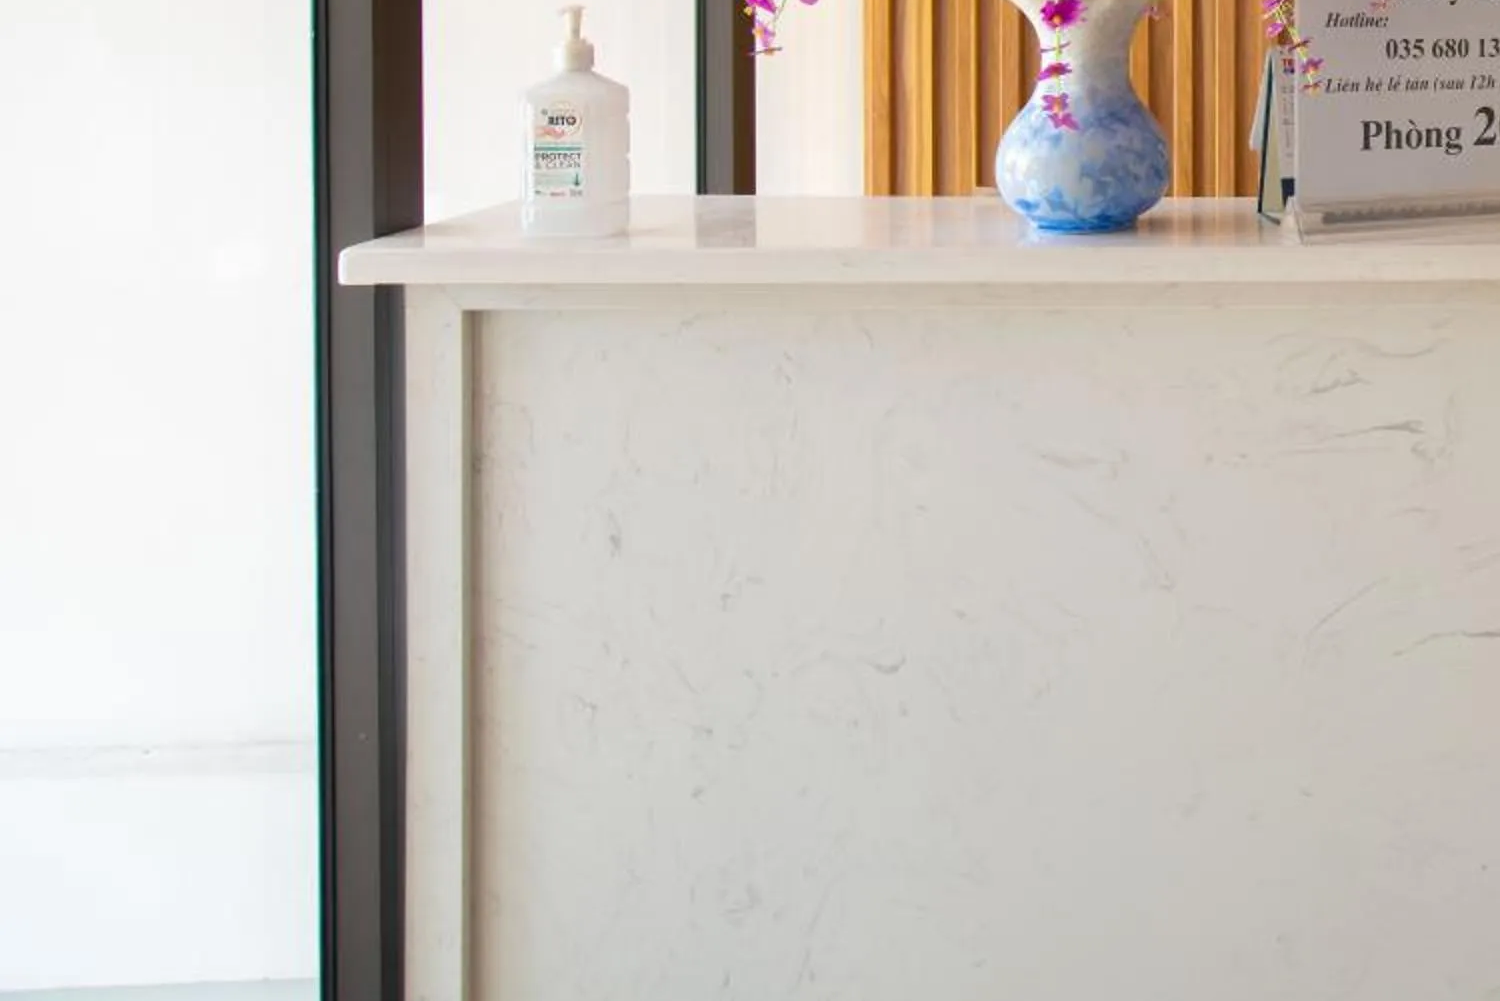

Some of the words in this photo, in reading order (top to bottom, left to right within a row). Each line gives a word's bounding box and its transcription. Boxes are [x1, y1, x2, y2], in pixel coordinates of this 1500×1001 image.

[1325, 12, 1389, 28] Hotline:
[1385, 38, 1425, 59] 035
[1431, 38, 1469, 59] 680
[1360, 120, 1462, 154] Phòng
